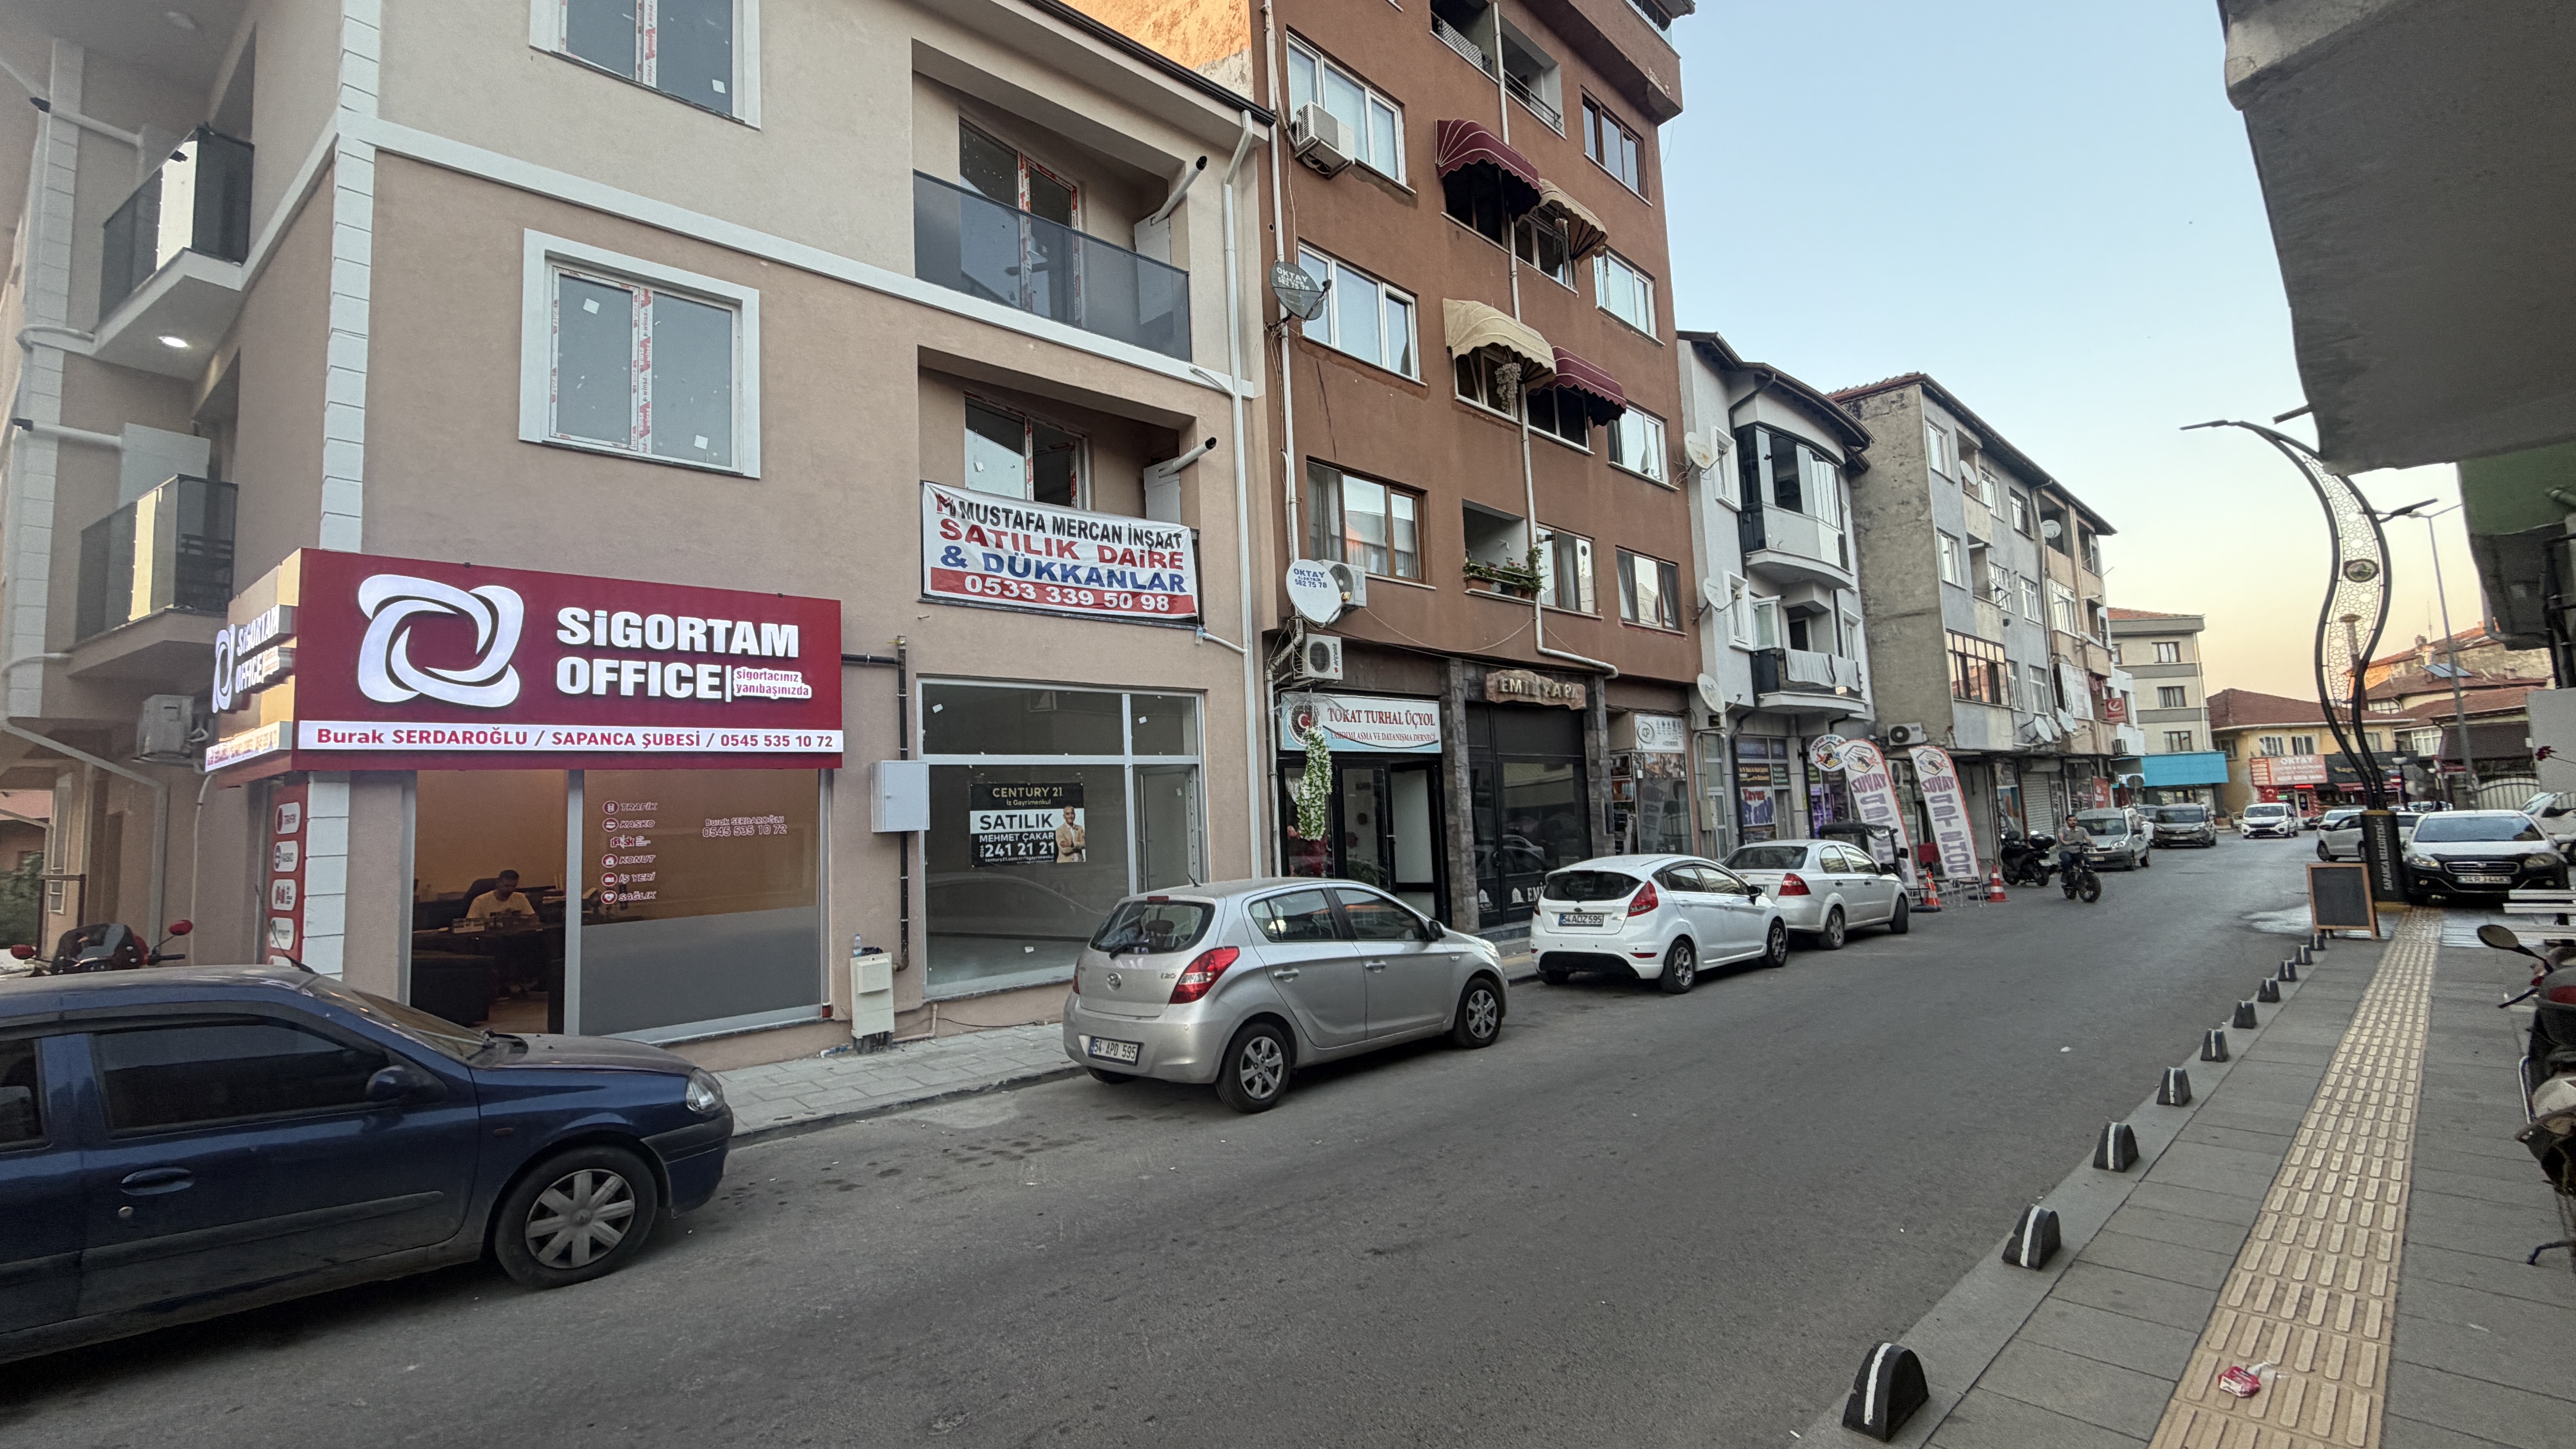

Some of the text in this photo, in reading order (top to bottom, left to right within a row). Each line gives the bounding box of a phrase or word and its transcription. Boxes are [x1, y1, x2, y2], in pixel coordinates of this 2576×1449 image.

[1277, 267, 1308, 282] OKTAY
[960, 500, 1182, 551] MUSTAFA MERCAN İNŞAAT
[939, 518, 1081, 561] SATILIK
[940, 546, 1187, 593] & DÜKKANLAR
[1293, 568, 1325, 578] OKTAY
[965, 575, 1170, 612] 0533 339 50 98
[557, 656, 722, 699] OFFICE
[736, 669, 799, 683] sigortacınız
[736, 682, 809, 697] yanıbaşınızda
[1328, 708, 1435, 729] TOKAT TURHAL ÜÇYOL
[317, 727, 833, 749] Burak SERDAROĞLU / SAPANCA ŞUBESİ / 0545 535 10 72
[2280, 756, 2313, 765] OKTAY
[993, 787, 1063, 798] CENTURY 21
[621, 802, 658, 811] TRAFİK
[1013, 799, 1051, 807] Gayrimenkul
[619, 819, 655, 829] KASKO
[705, 818, 730, 826] Burak
[980, 813, 1053, 830] SATILIK
[703, 824, 787, 837] 0545 535 10 72
[979, 832, 1054, 843] MEHMET ÇAKAR
[985, 842, 1054, 857] 241 21 21
[619, 855, 656, 865] KONUT
[619, 872, 656, 884] İŞ YERİ
[618, 891, 657, 902] SAĞLIK
[1588, 914, 1602, 924] 595
[1094, 1040, 1136, 1059] 54 APD 595
